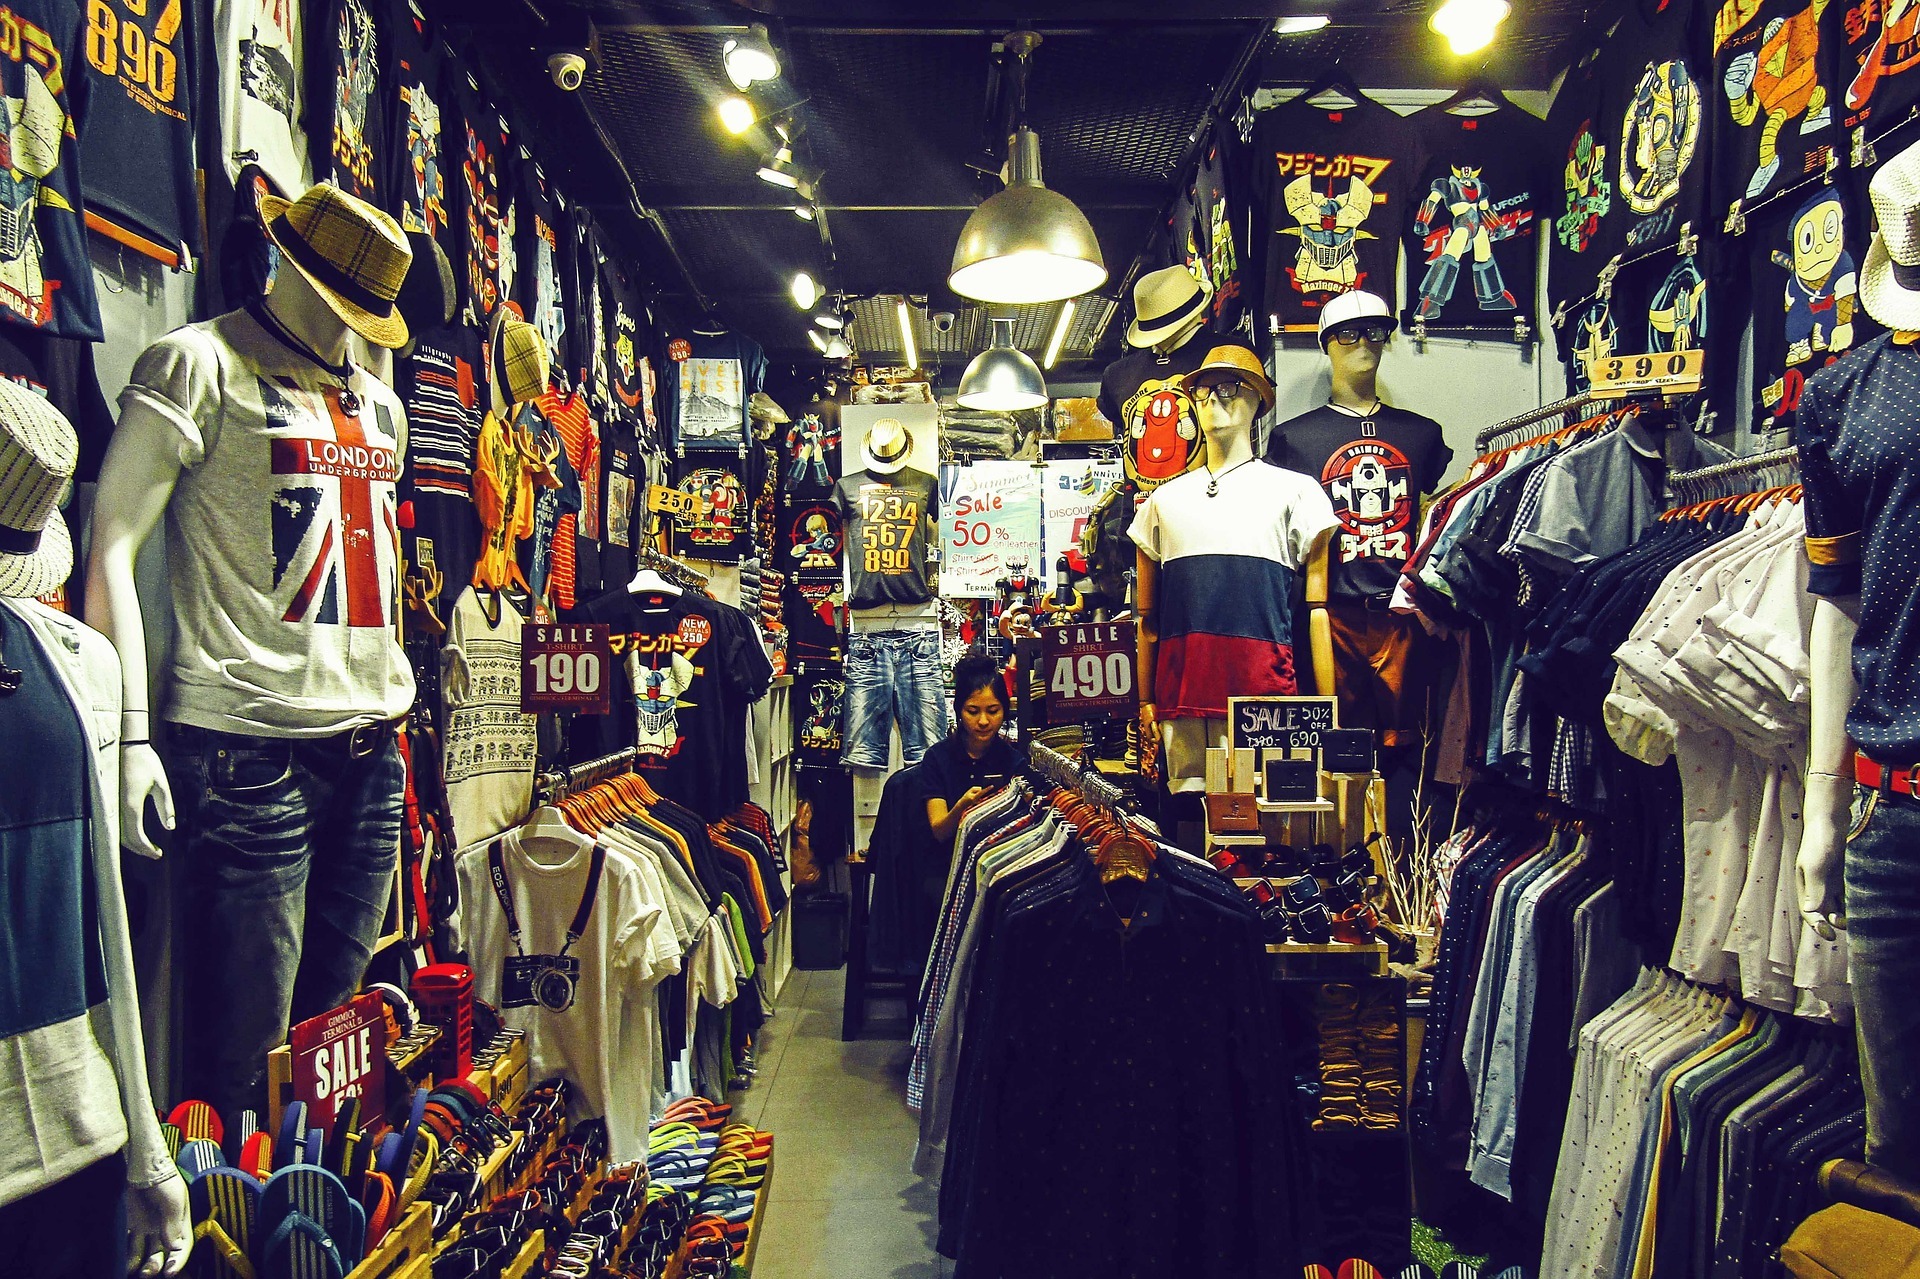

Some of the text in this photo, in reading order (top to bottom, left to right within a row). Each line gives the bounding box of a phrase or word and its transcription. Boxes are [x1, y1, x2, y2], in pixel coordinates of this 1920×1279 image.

[86, 0, 177, 102] 890
[1302, 280, 1343, 294] Mazinger
[669, 341, 687, 350] NEW
[1606, 355, 1686, 380] 390
[306, 440, 396, 471] LONDON
[1347, 445, 1386, 459] DAIMOS
[660, 491, 694, 511] 250
[856, 496, 917, 526] 1234
[955, 492, 1003, 516] Sale
[862, 522, 915, 549] 567
[1007, 539, 1039, 549] leather
[1340, 530, 1407, 564] ダイモス
[864, 548, 909, 573] 890
[952, 554, 974, 563] Shirt
[682, 618, 707, 628] NEW
[537, 628, 593, 643] SALE
[1058, 626, 1118, 645] SALE
[546, 643, 584, 651] T-SHIRT
[1073, 643, 1104, 652] SHIRT
[529, 652, 600, 693] 190
[1051, 652, 1131, 698] 490
[1241, 706, 1330, 732] SALE 50%
[1310, 722, 1327, 730] OFF
[492, 866, 504, 888] EOS
[328, 1008, 356, 1027] GIMMICK
[322, 1019, 356, 1041] TERMINAL
[314, 1027, 371, 1099] SALE
